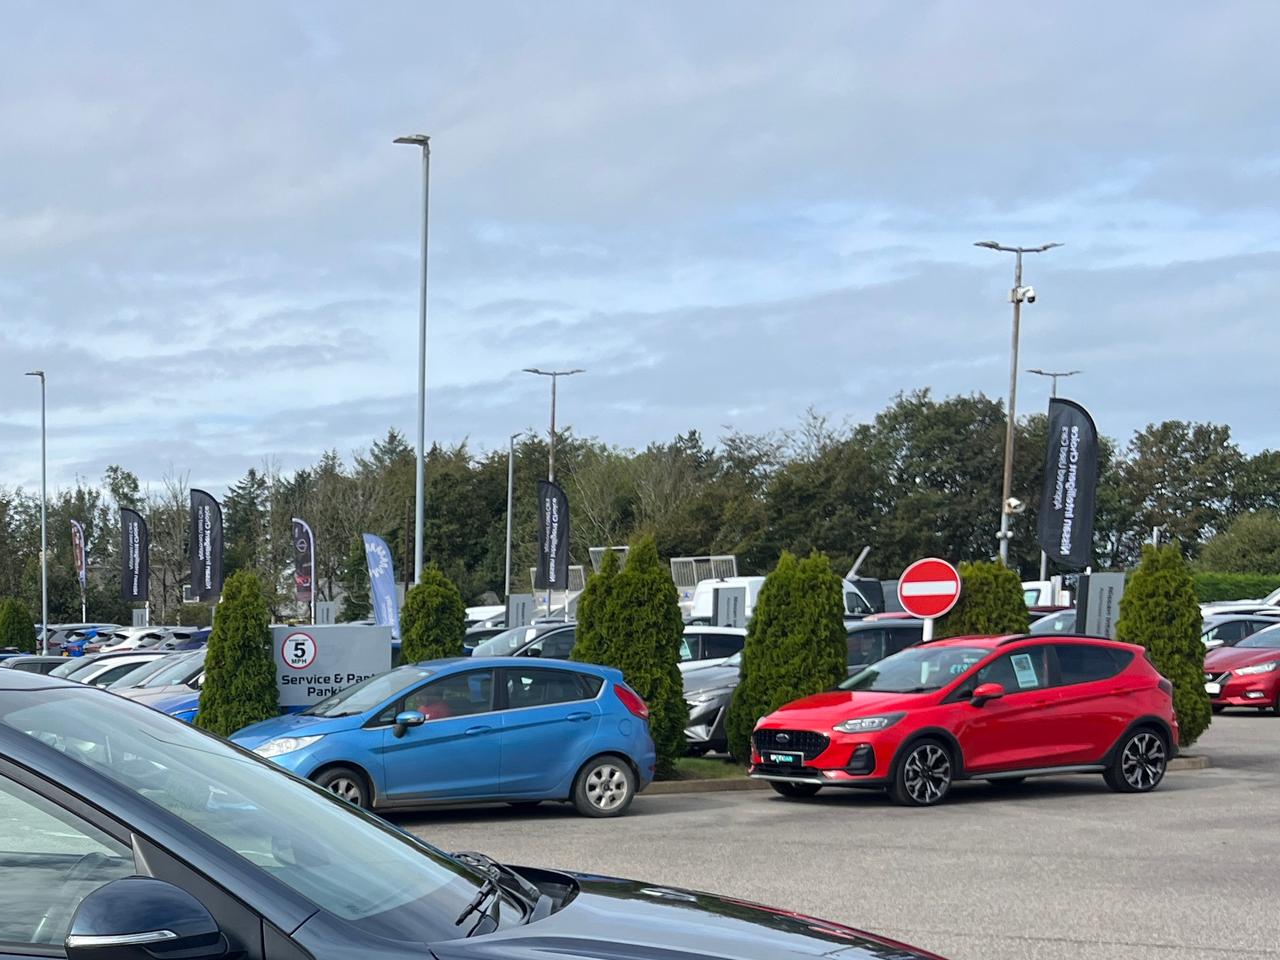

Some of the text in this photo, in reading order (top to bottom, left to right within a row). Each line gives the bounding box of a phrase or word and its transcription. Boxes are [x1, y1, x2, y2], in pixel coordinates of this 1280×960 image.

[294, 642, 306, 658] 5
[282, 675, 331, 685] Service
[334, 674, 344, 684] &
